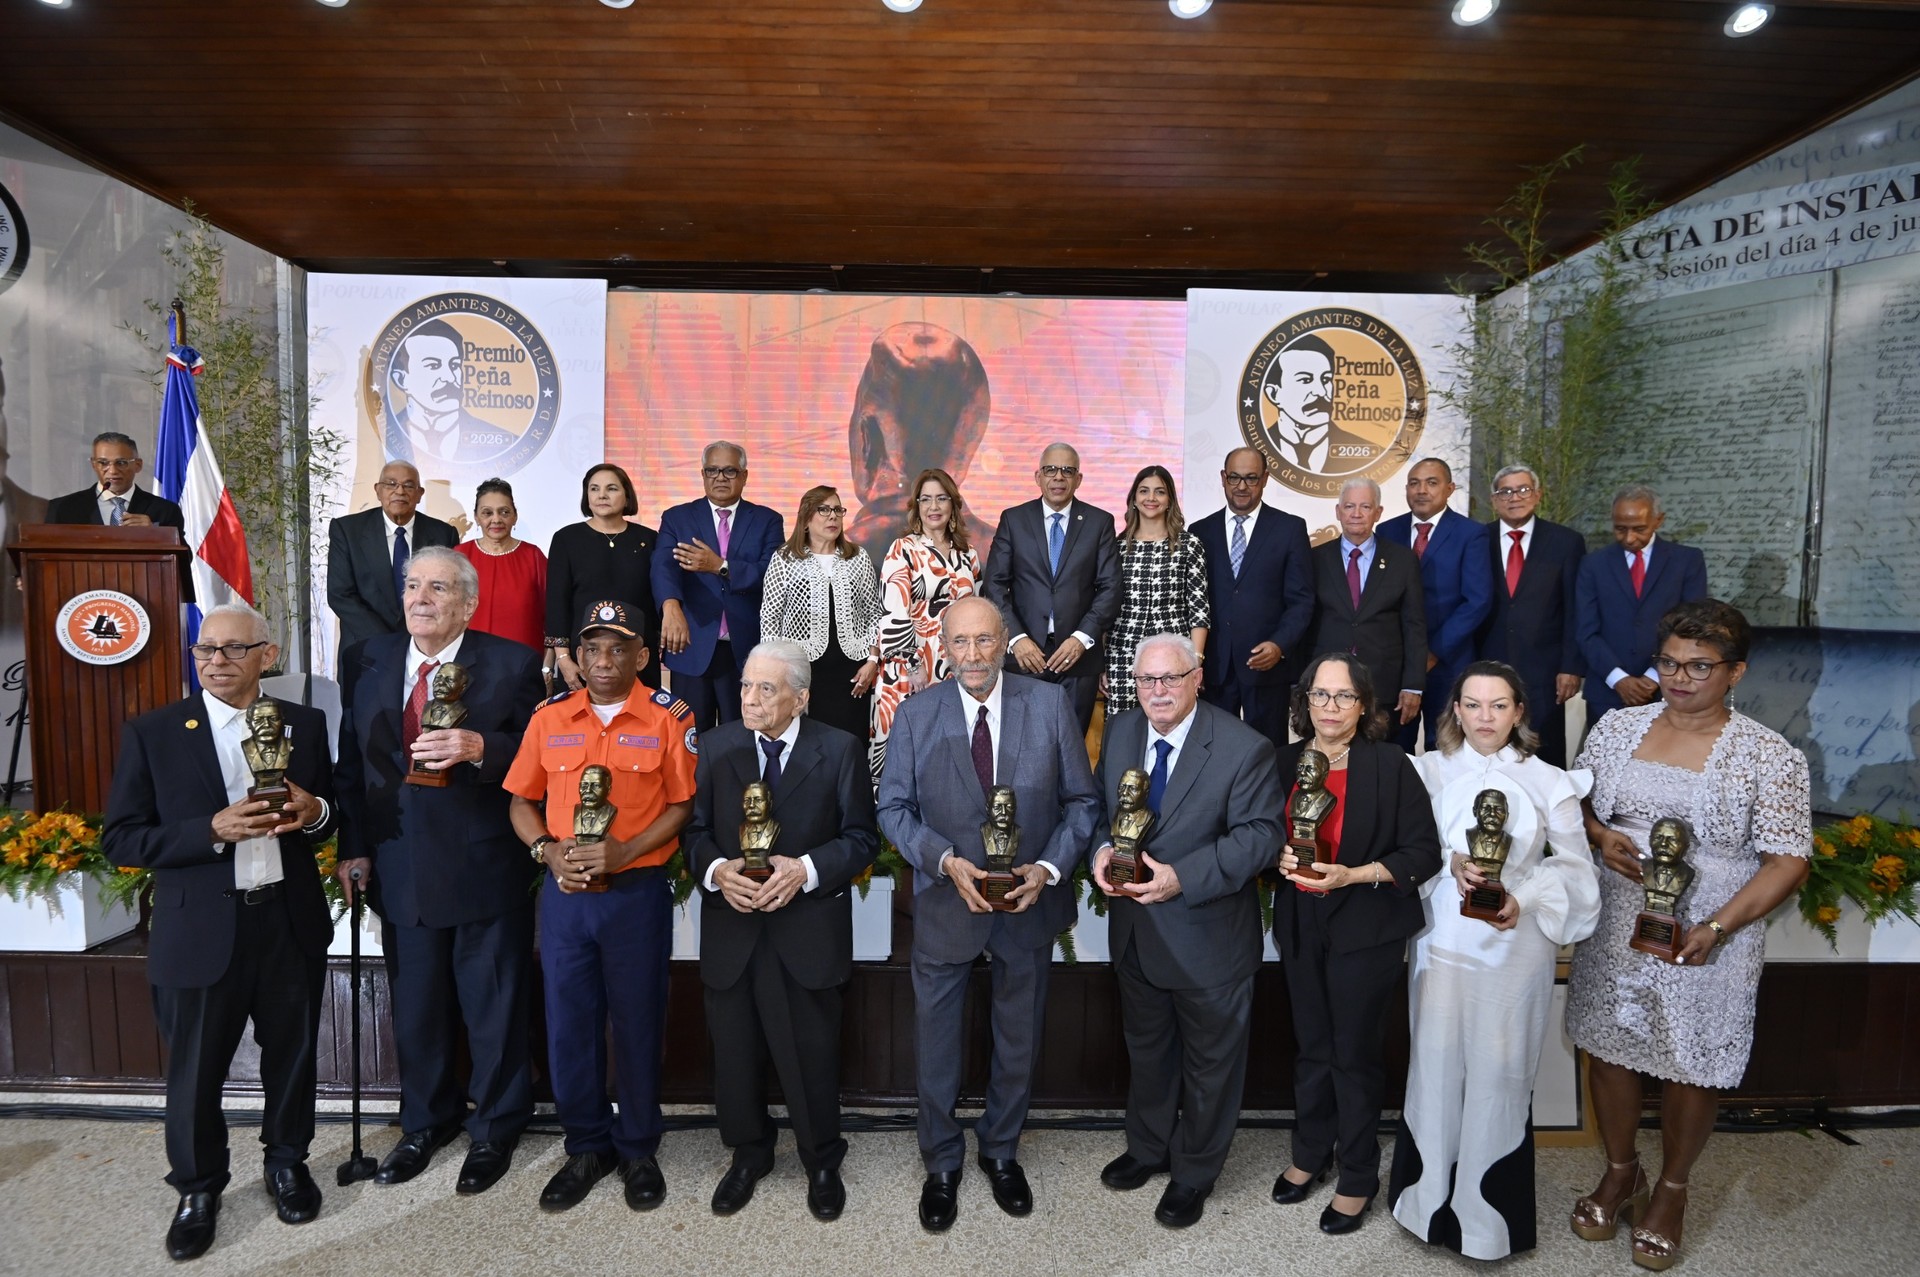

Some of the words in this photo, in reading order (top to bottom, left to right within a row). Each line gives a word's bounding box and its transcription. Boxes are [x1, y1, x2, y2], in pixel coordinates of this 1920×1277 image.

[1712, 209, 1765, 244] DE
[1655, 252, 1727, 281] Sesión
[1735, 241, 1770, 266] del
[1779, 235, 1817, 257] día
[1824, 226, 1841, 247] 4
[1850, 219, 1881, 242] de
[375, 317, 412, 374] ATENEO
[415, 298, 490, 320] AMANTES
[494, 307, 517, 326] DE
[517, 324, 535, 345] LA
[533, 346, 551, 377] LUZ
[463, 341, 526, 363] Premio
[1248, 332, 1287, 389] ATENEO
[1291, 312, 1362, 335] AMANTES
[1366, 321, 1388, 340] DE
[1387, 338, 1405, 358] LA
[1401, 359, 1419, 390] LUZ
[463, 365, 512, 386] Peña
[1334, 356, 1395, 376] Premio
[463, 387, 535, 410] Reinoso
[1334, 378, 1380, 399] Peña
[1333, 401, 1401, 422] Reinoso
[470, 432, 503, 445] 2026
[1338, 445, 1370, 457] 2026
[1281, 468, 1297, 483] de
[1301, 476, 1321, 491] los
[64, 597, 84, 617] ATENEO
[84, 592, 117, 600] AMANTES
[590, 600, 613, 622] DEFENSA
[614, 605, 627, 623] CIVIL
